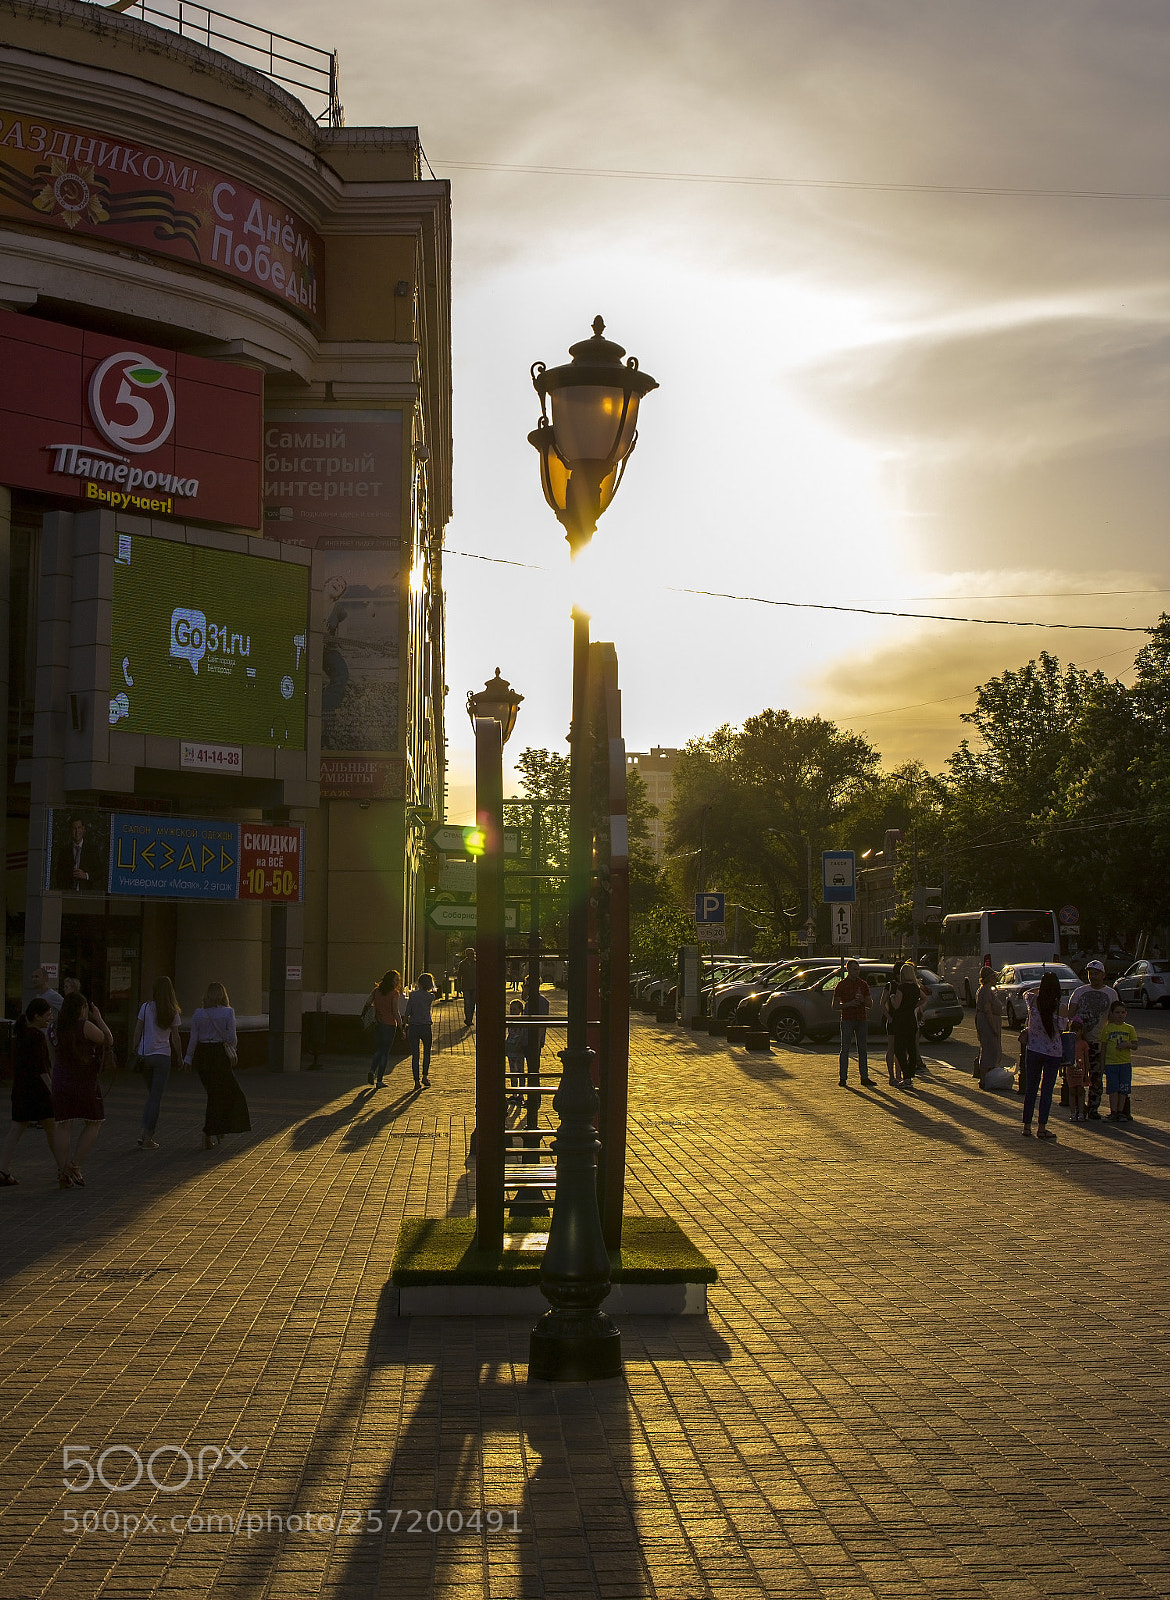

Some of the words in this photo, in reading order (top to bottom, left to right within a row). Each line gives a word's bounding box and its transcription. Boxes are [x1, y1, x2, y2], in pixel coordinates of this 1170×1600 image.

[0, 119, 198, 194] АЗДНИКОМ!
[212, 182, 237, 222] С
[243, 198, 309, 266] Днём
[211, 224, 317, 315] Победы!
[108, 377, 155, 440] 5
[265, 427, 347, 450] Самый
[45, 444, 200, 498] Пятёрочка
[264, 452, 376, 477] быстрый
[86, 482, 173, 514] Выручает!
[264, 480, 384, 501] интернет
[174, 618, 251, 657] Go31.ru
[197, 749, 239, 766] 41-14-33
[122, 824, 151, 835] САЛОН
[156, 827, 198, 838] МУЖСКОЙ
[201, 830, 233, 841] ОДЕЖДЫ
[243, 832, 298, 853] СКИДКИ
[117, 837, 235, 873] ЦЕЗАРЬ
[256, 858, 266, 867] на
[269, 855, 284, 868] ВСЁ
[119, 875, 167, 889] Универмаг
[203, 879, 209, 890] 2
[211, 882, 232, 892] этаж
[247, 868, 265, 895] 10
[703, 896, 720, 920] P
[836, 923, 849, 935] 15
